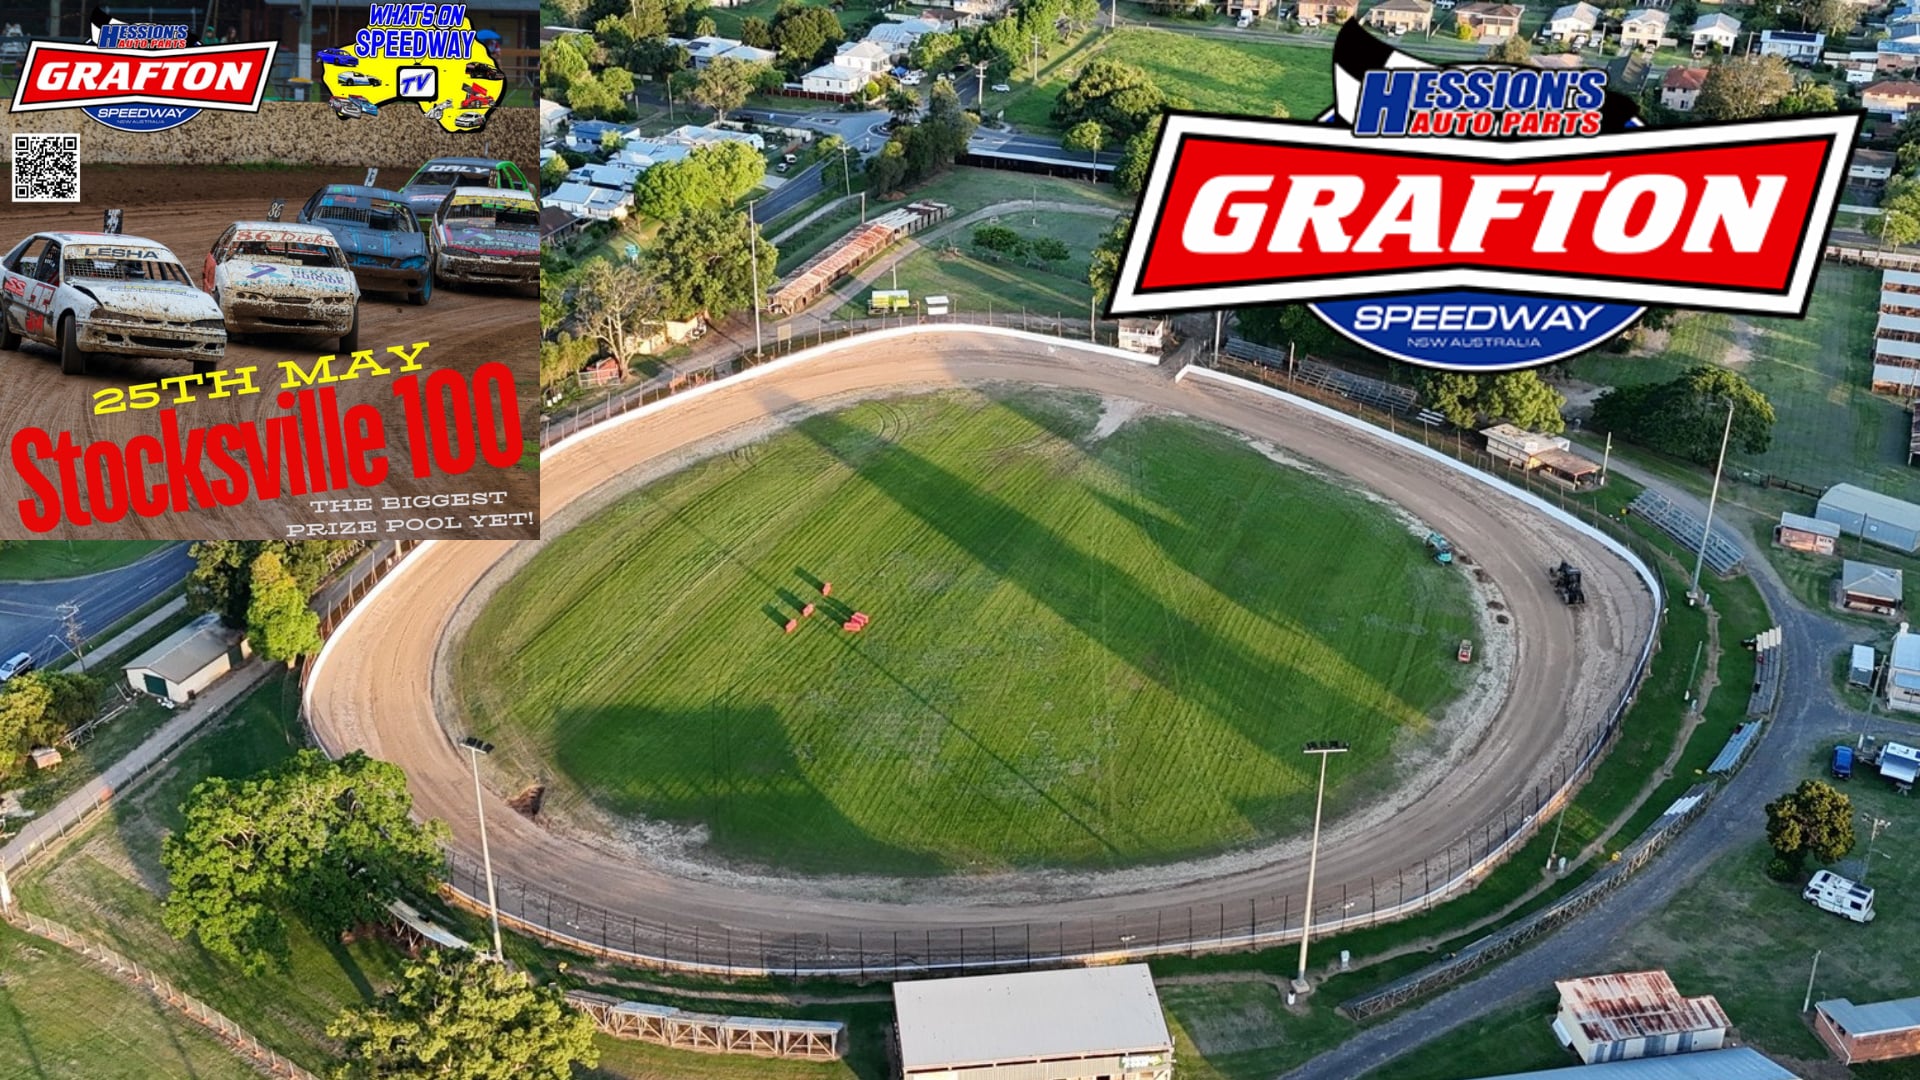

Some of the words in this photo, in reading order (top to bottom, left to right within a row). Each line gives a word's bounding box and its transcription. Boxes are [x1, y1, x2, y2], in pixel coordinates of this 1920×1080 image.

[427, 165, 490, 173] DALY
[267, 202, 285, 218] 86
[236, 231, 271, 241] 86
[85, 247, 159, 260] LESHA
